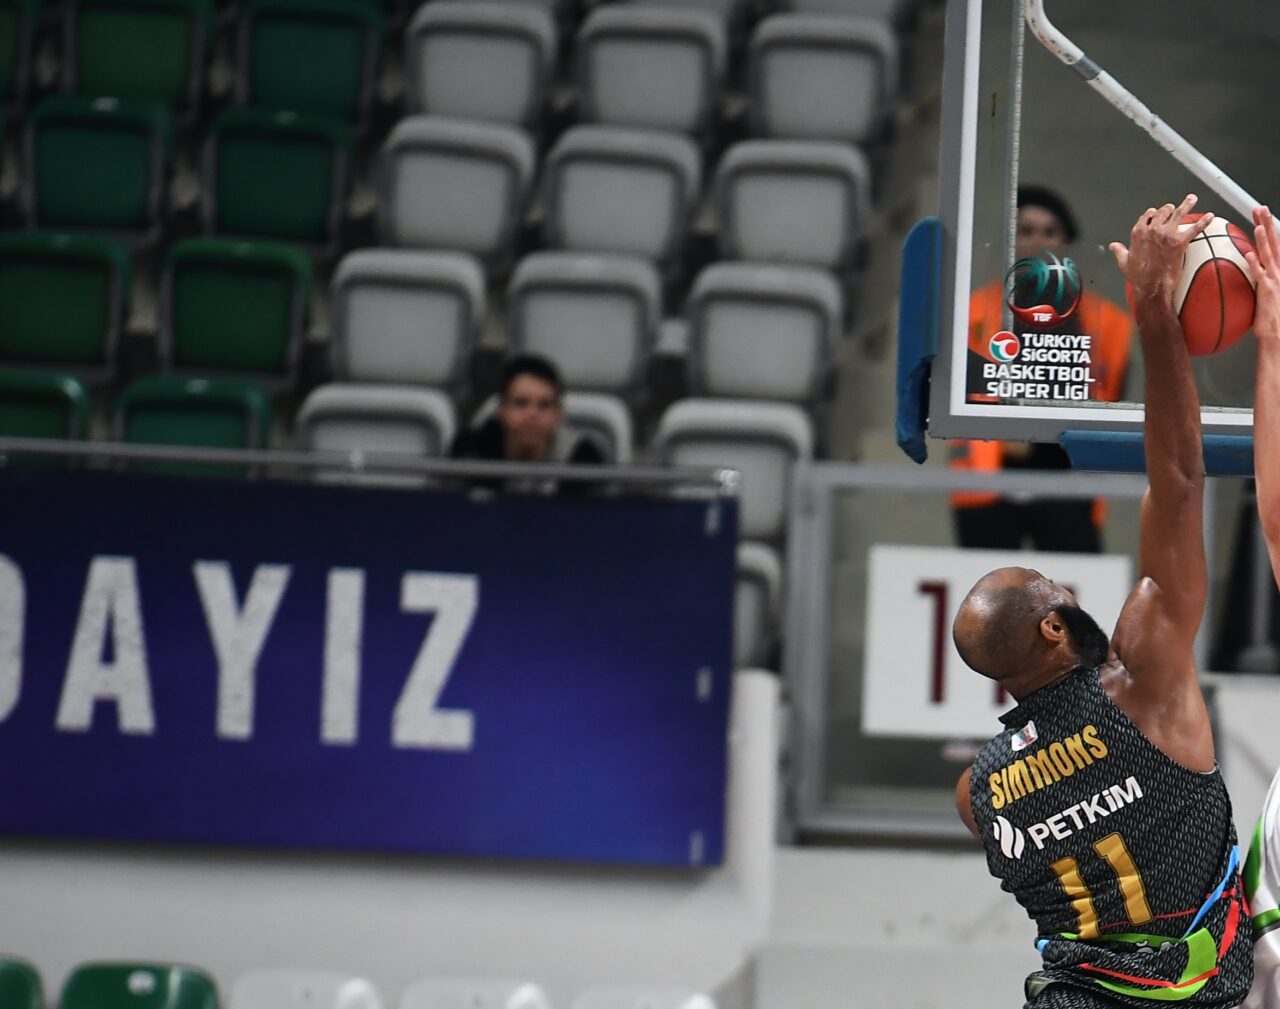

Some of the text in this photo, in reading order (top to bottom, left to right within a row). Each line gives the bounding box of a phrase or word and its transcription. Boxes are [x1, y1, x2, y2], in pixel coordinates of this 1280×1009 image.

[983, 363, 1096, 383] BASKETBOL
[986, 380, 1050, 399] SÜPER
[989, 724, 1108, 810] SIMMONS
[1050, 831, 1154, 940] 11
